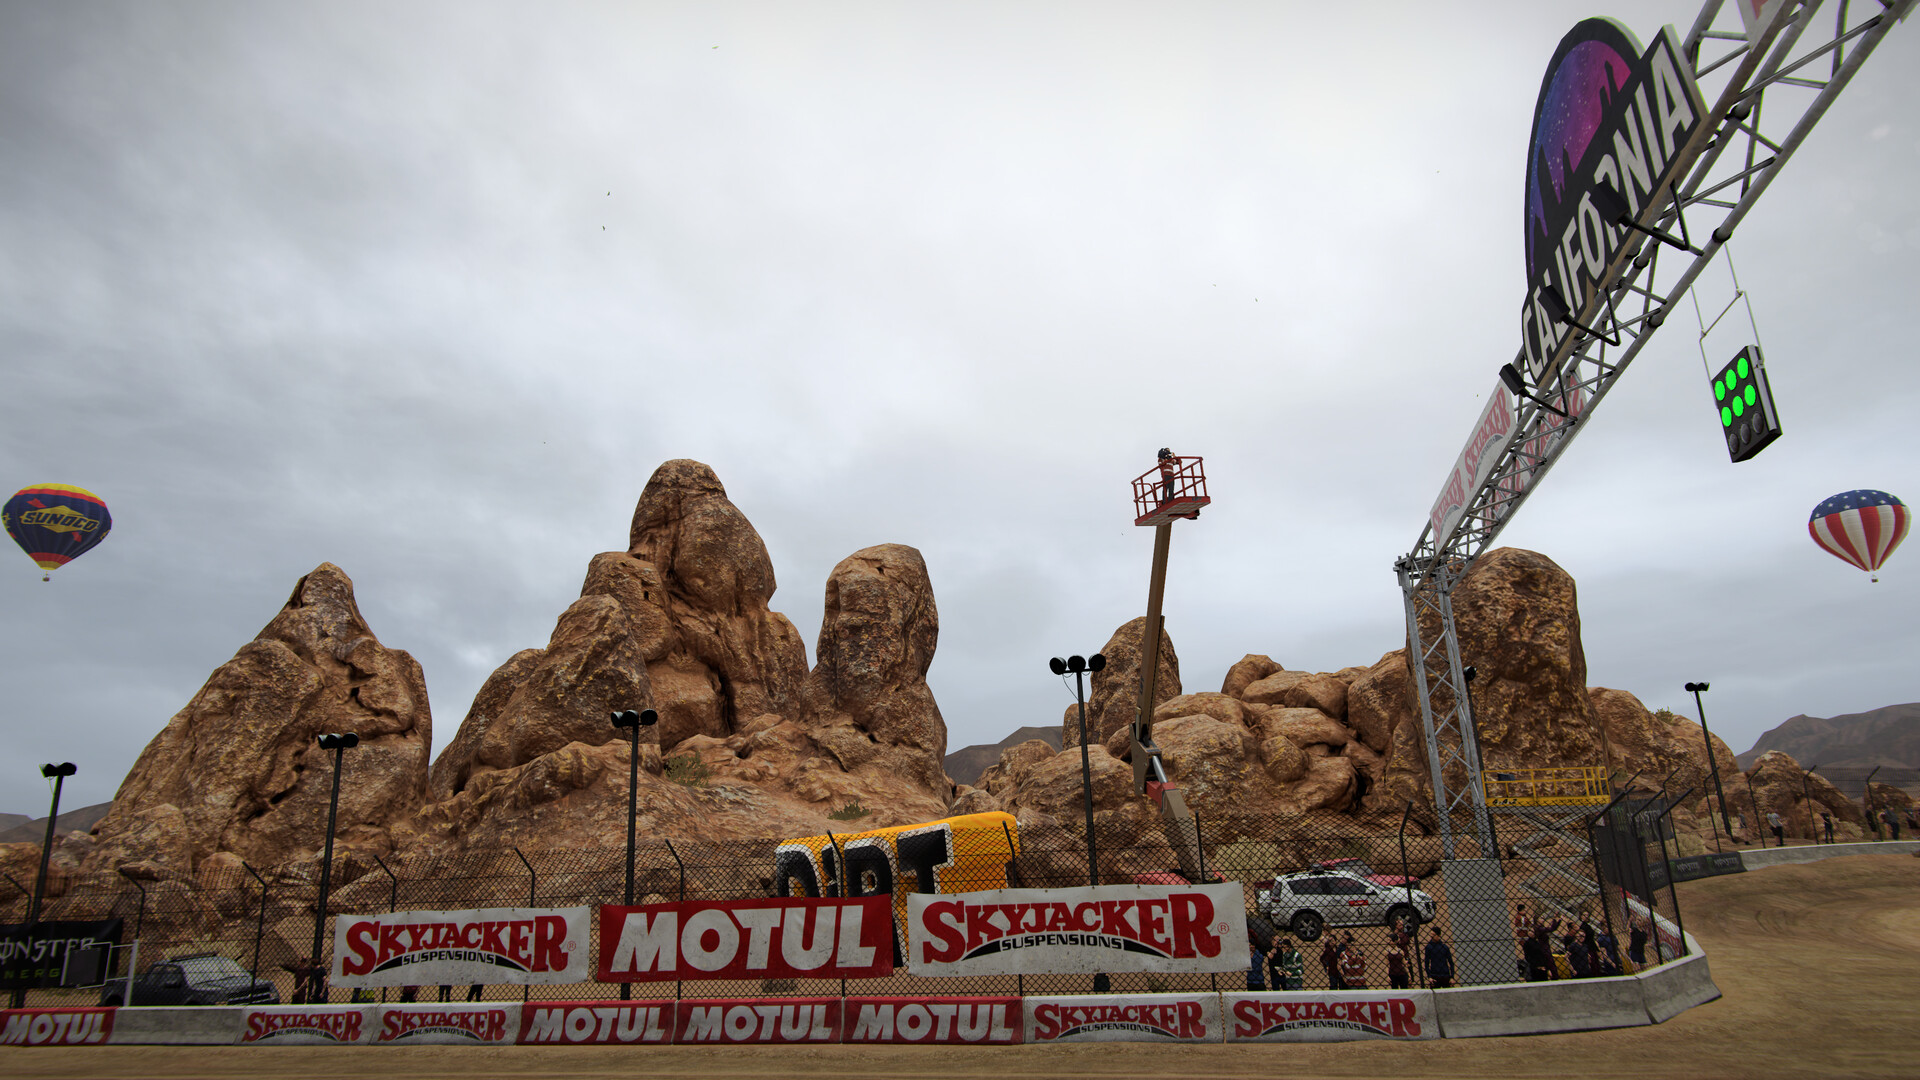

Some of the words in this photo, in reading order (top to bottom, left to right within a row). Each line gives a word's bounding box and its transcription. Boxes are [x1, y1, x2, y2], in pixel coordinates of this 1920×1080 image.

[24, 511, 98, 531] SUNOCO
[610, 904, 876, 972] MOTUL
[922, 893, 1221, 963] SKYJACKER
[1001, 934, 1122, 950] SUSPENSIONS
[342, 915, 569, 976] SKYJACKER
[402, 951, 495, 966] SUSPENSIONS
[1, 1013, 108, 1044] MOTUL
[242, 1011, 363, 1042] SKYJACKER
[377, 1010, 506, 1042] SKYJACKER
[525, 1007, 666, 1042] MOTUL
[683, 1005, 832, 1041] MOTUL
[852, 1003, 1014, 1041] MOTUL
[1034, 1001, 1206, 1040] SKYJACKER
[1080, 1023, 1150, 1033] SUSPENSIONS
[1233, 998, 1422, 1038] SKYJACKER
[1285, 1020, 1360, 1031] SUSPENSIONS
